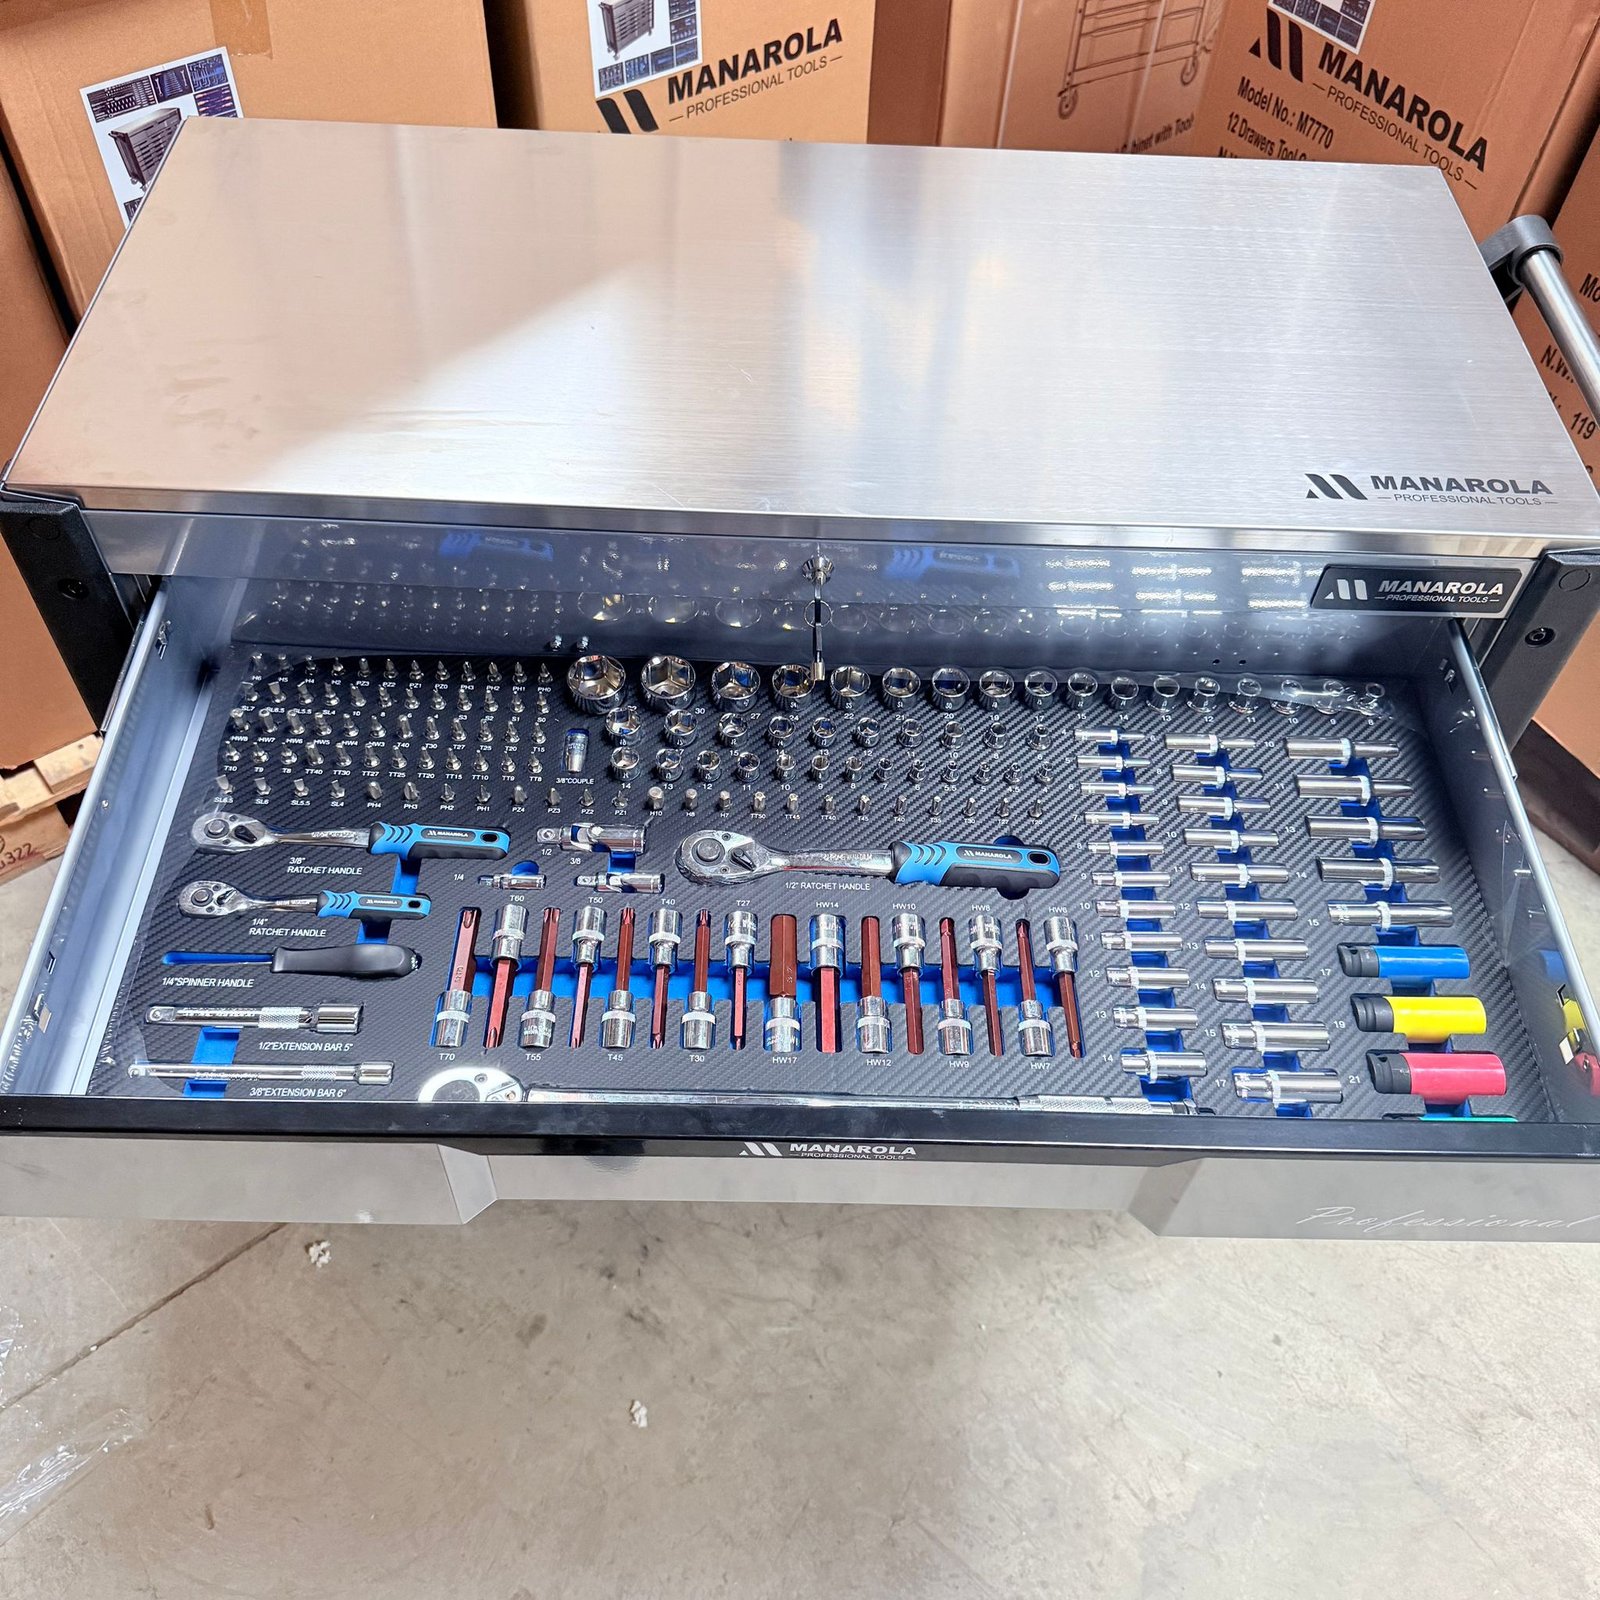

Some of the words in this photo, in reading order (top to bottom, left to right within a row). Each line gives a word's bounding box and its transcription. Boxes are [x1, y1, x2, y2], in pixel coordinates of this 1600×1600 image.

[667, 18, 843, 105] MANAROLA
[686, 73, 784, 120] PROFESSIONAL
[788, 55, 827, 85] TOOLS
[1318, 42, 1489, 173] MANAROLA
[1237, 76, 1272, 112] Model
[1272, 96, 1296, 127] No.:
[1297, 110, 1334, 150] M7770
[1226, 111, 1240, 134] 12
[1237, 119, 1275, 157] Drawers
[1326, 85, 1421, 155] PROFESSIONAL
[1422, 143, 1465, 183] TOOLS
[1370, 474, 1554, 495] MANAROLA
[1393, 493, 1496, 505] PROFESSIONAL
[1497, 496, 1542, 506] TOOLS
[1378, 578, 1503, 596] MANAROLA
[1385, 594, 1456, 604] PROFESSIONAL
[1458, 595, 1489, 604] TOOLS
[541, 848, 552, 856] 1/2
[974, 850, 1013, 860] MANAROLA
[570, 857, 582, 865] 3/8
[287, 866, 327, 874] RATCHET
[329, 866, 362, 875] HANDLE
[452, 873, 464, 881] 1/4
[800, 882, 837, 890] RATCHET
[252, 918, 268, 926] 1/4"
[1307, 918, 1320, 926] 15
[249, 927, 292, 936] RATCHET
[294, 928, 326, 938] HANDLE
[1187, 942, 1198, 950] 13
[1089, 970, 1100, 978] 12
[1320, 968, 1332, 976] 17
[162, 977, 216, 987] 1/4"SPINNER
[217, 978, 254, 988] HANDLE
[1194, 982, 1206, 990] 14
[1096, 1011, 1106, 1019] 13
[1334, 1020, 1346, 1028] 19
[1204, 1029, 1216, 1037] 15
[258, 1042, 324, 1051] 1/2"EXTENSION
[324, 1042, 343, 1052] BAR
[343, 1043, 354, 1052] 5"
[438, 1052, 456, 1061] T70
[525, 1053, 542, 1062] T55
[608, 1054, 624, 1062] T45
[689, 1054, 706, 1062] T30
[772, 1056, 798, 1064] HW17
[949, 1060, 970, 1068] HW9
[1215, 1079, 1227, 1088] 17
[1348, 1075, 1361, 1084] 21
[249, 1087, 316, 1096] 3/8"EXTENSION
[316, 1088, 336, 1097] BAR
[336, 1088, 347, 1098] 6"
[790, 1143, 917, 1155] MANAROLA
[800, 1152, 872, 1160] PROFESSIONAL
[1296, 1206, 1600, 1233] Professional
